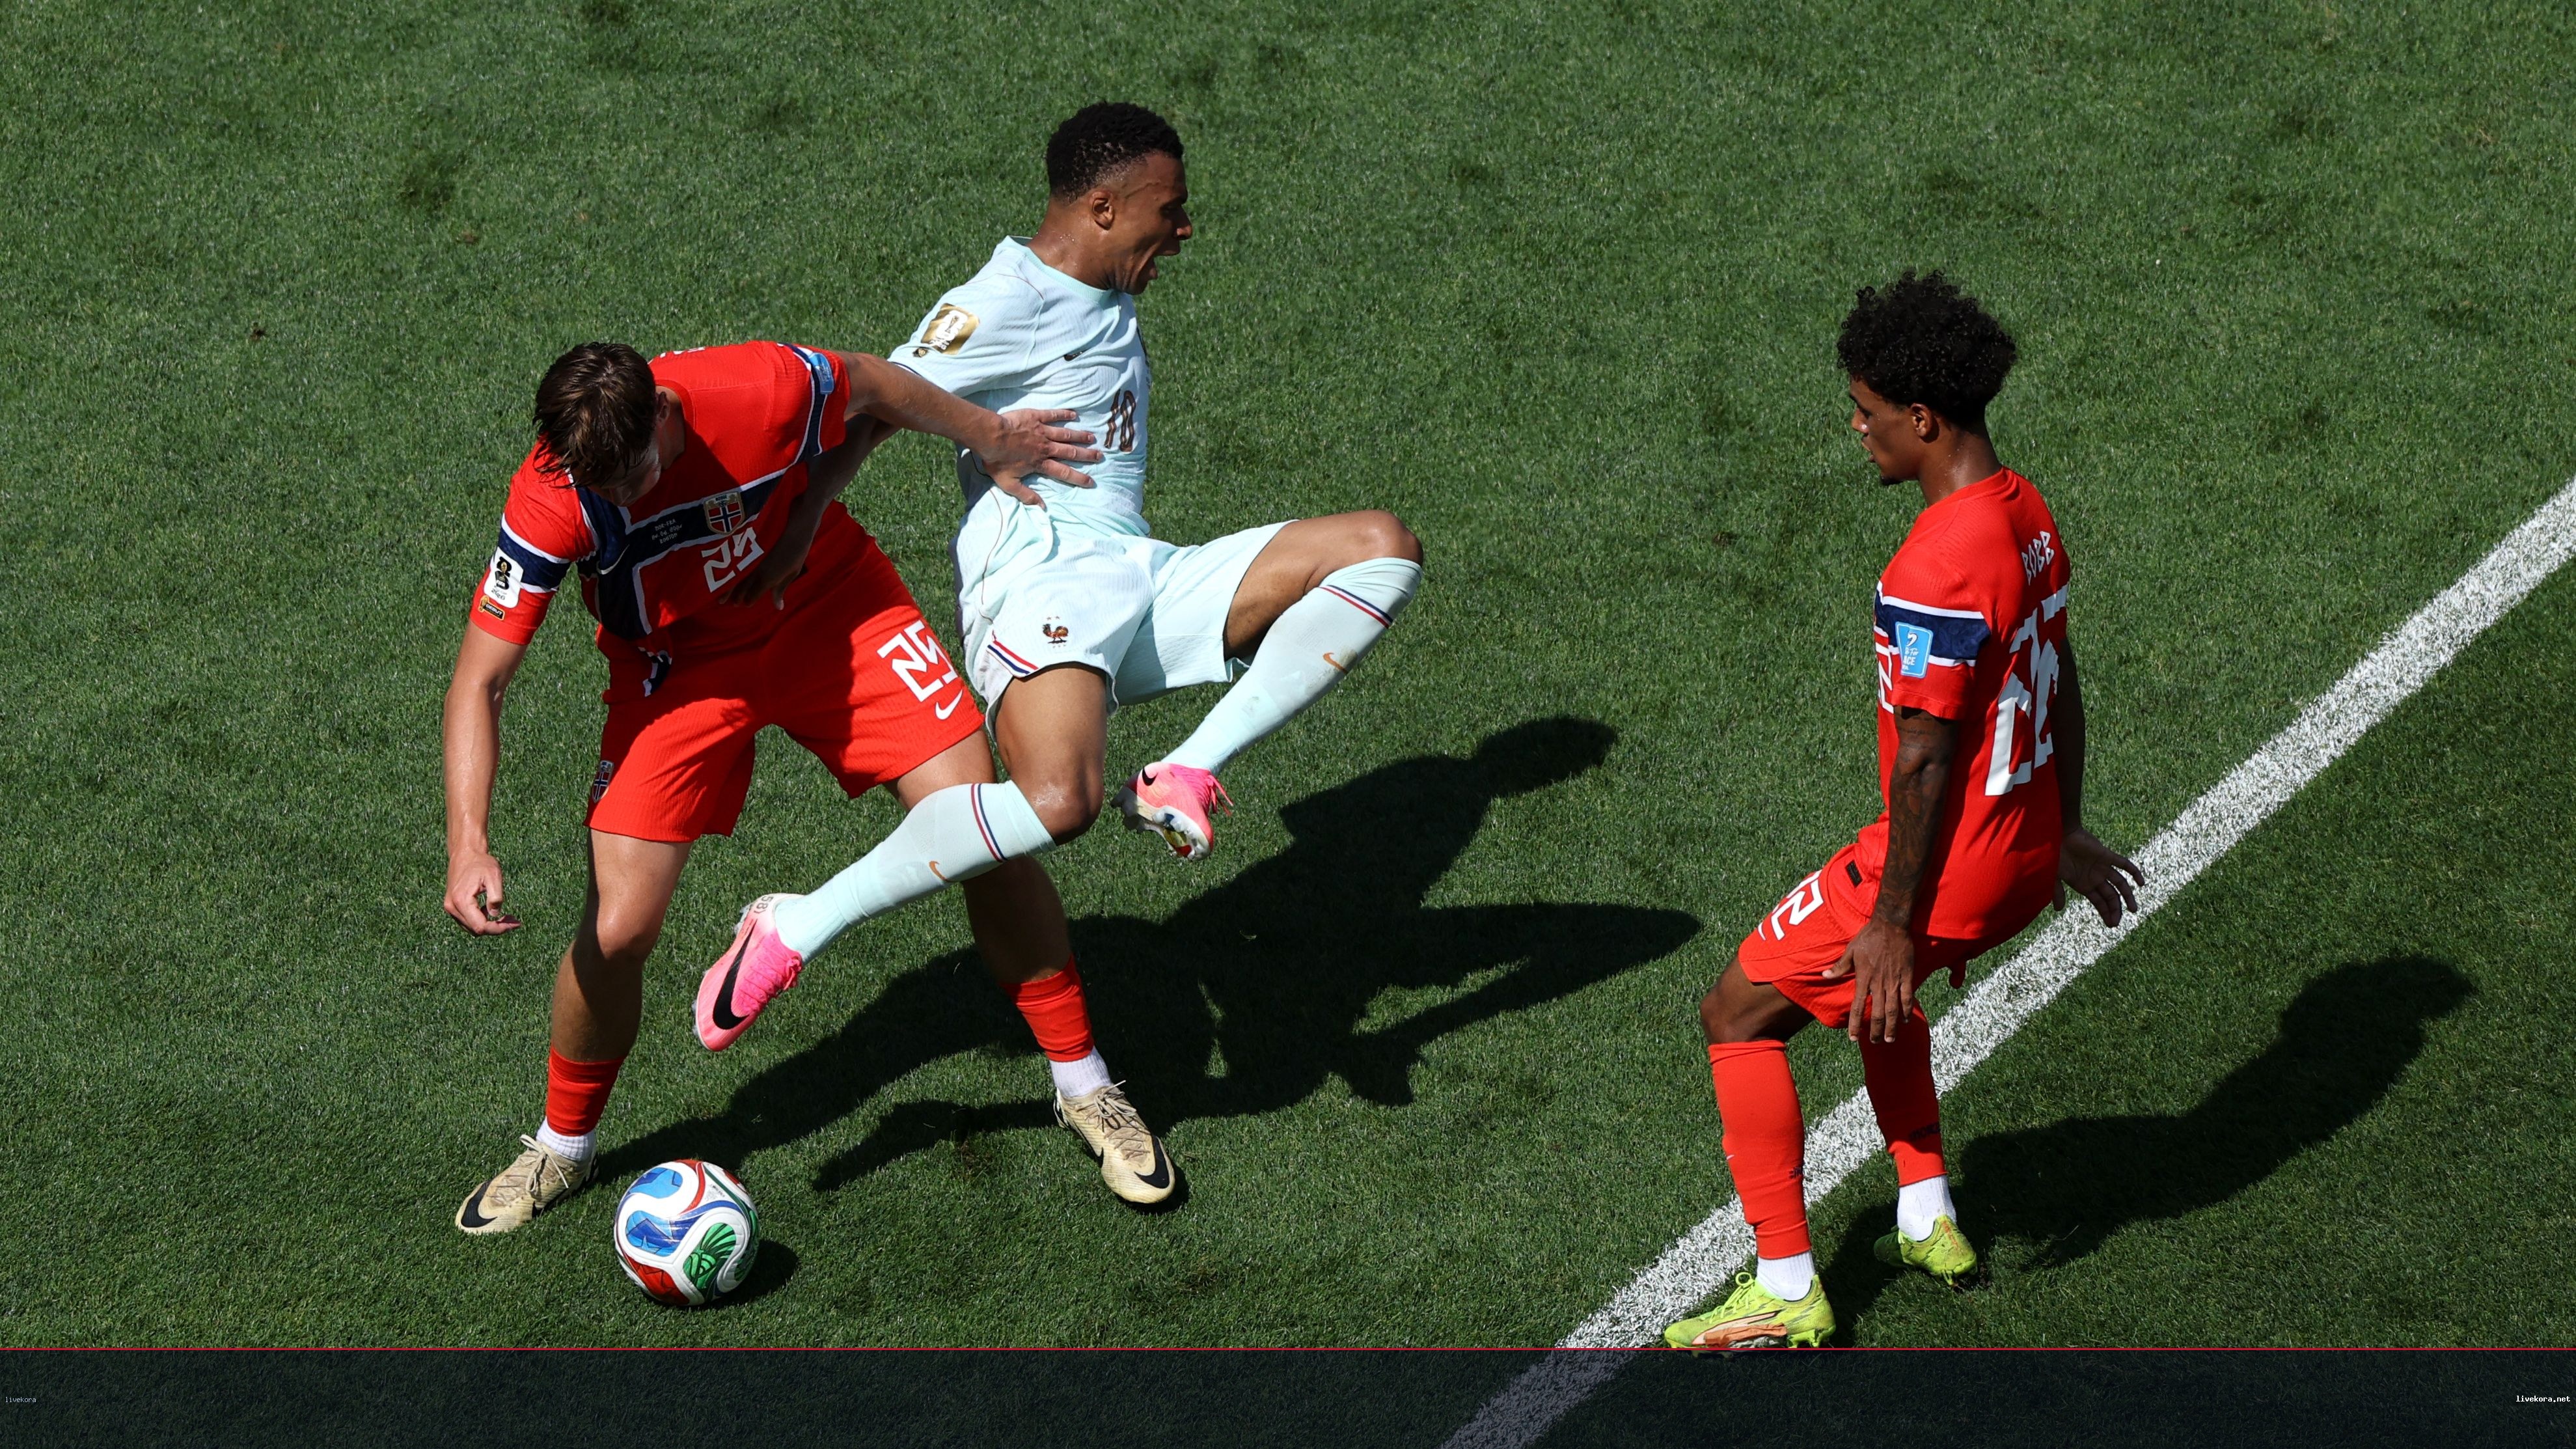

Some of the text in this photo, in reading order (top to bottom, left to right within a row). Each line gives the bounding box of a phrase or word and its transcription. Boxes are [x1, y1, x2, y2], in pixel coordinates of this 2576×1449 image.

[1104, 388, 1136, 452] 10
[701, 527, 765, 593] 25
[2021, 531, 2055, 586] BOBB
[877, 620, 958, 702] 25
[1875, 642, 1895, 714] 2
[1985, 584, 2068, 796] 22
